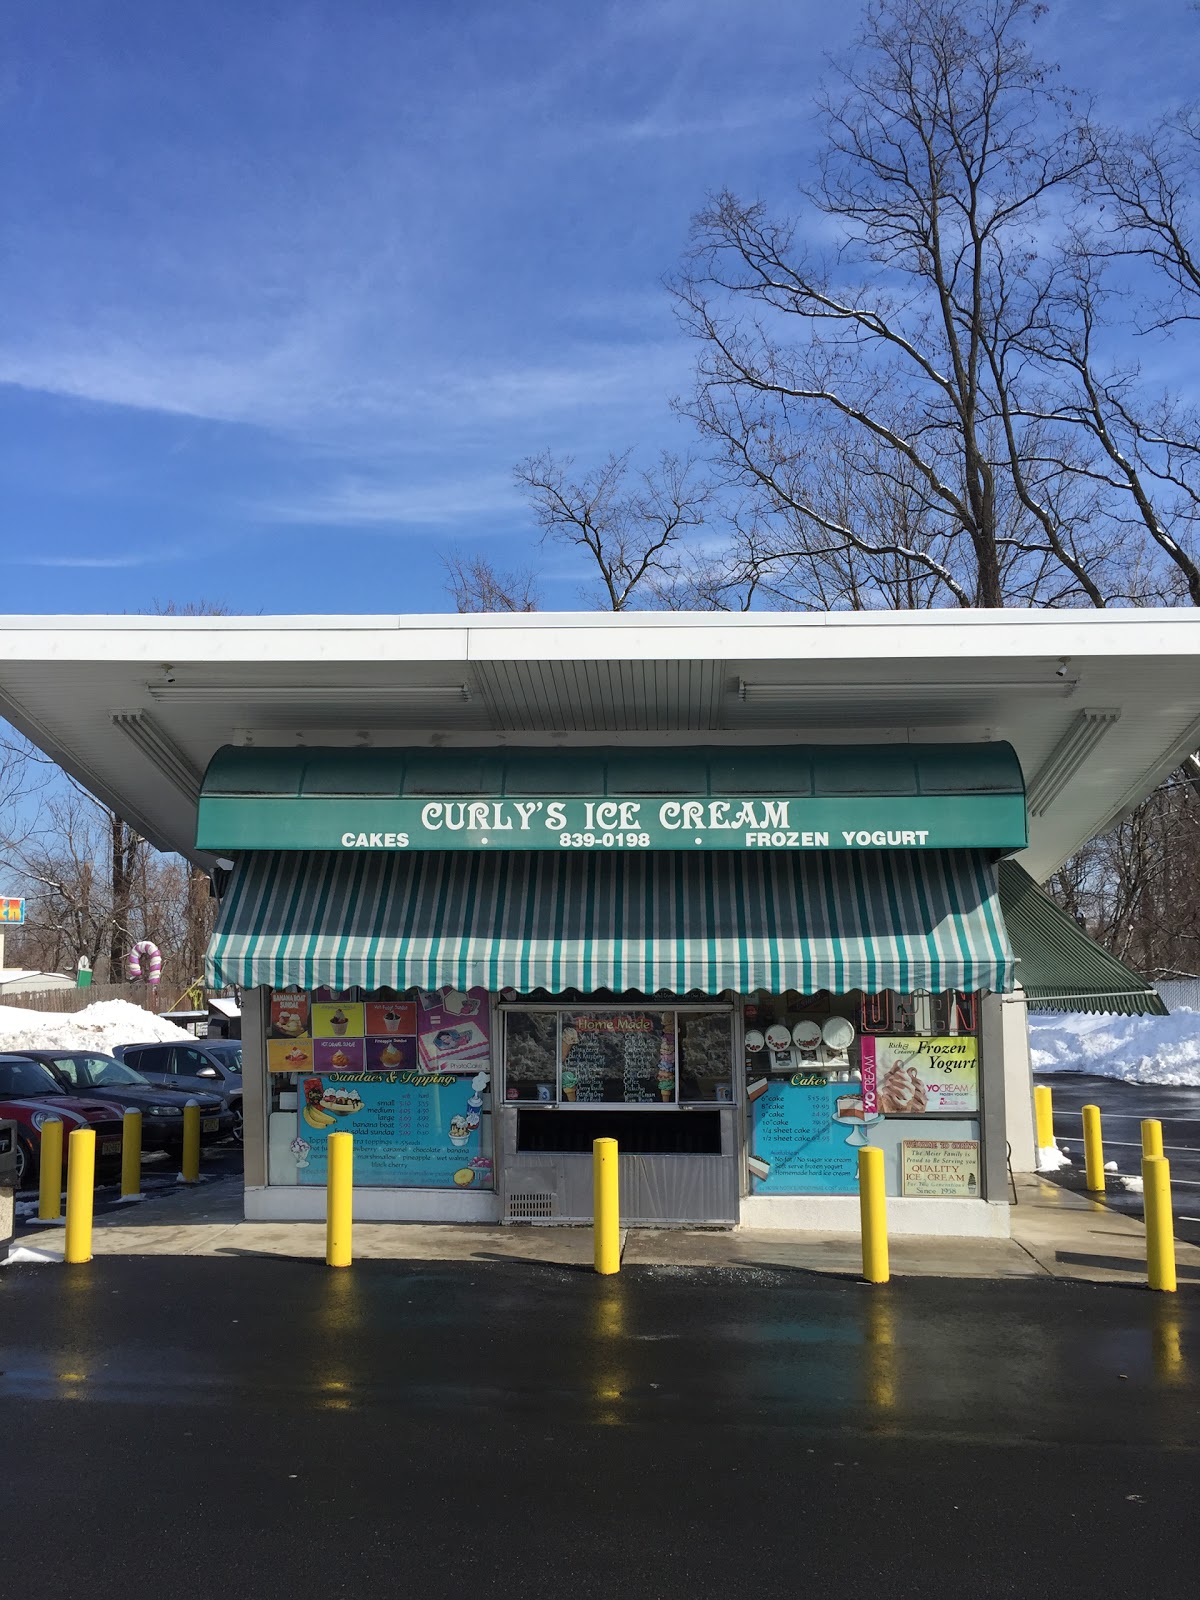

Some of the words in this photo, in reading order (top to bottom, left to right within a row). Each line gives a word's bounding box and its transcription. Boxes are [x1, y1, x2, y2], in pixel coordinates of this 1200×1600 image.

[421, 802, 567, 830] CURLY'S
[584, 802, 641, 830] ICE
[659, 801, 790, 830] CREAM
[341, 832, 409, 847] CAKES
[559, 833, 650, 847] 839-0198
[745, 832, 829, 847] FROZEN
[842, 831, 929, 846] YOGURT
[578, 1019, 613, 1029] Home
[617, 1018, 650, 1030] Made
[917, 1040, 966, 1054] Frozen
[928, 1055, 977, 1073] Yogurt
[329, 1071, 383, 1083] Sundaes
[386, 1071, 398, 1083] &
[399, 1072, 457, 1087] Toppings
[791, 1072, 827, 1086] Cakes
[926, 1084, 969, 1092] YOCREAM
[377, 1114, 395, 1122] large
[773, 1126, 793, 1134] sheet
[794, 1126, 811, 1134] cake
[365, 1138, 392, 1146] toppings
[774, 1134, 793, 1142] sheet
[794, 1134, 811, 1142] cake
[906, 1141, 937, 1149] WELCOME
[402, 1154, 431, 1162] pineapple
[942, 1157, 964, 1165] Serving
[912, 1165, 960, 1173] QUALITY
[906, 1173, 921, 1181] ICE
[927, 1173, 965, 1182] CREAM
